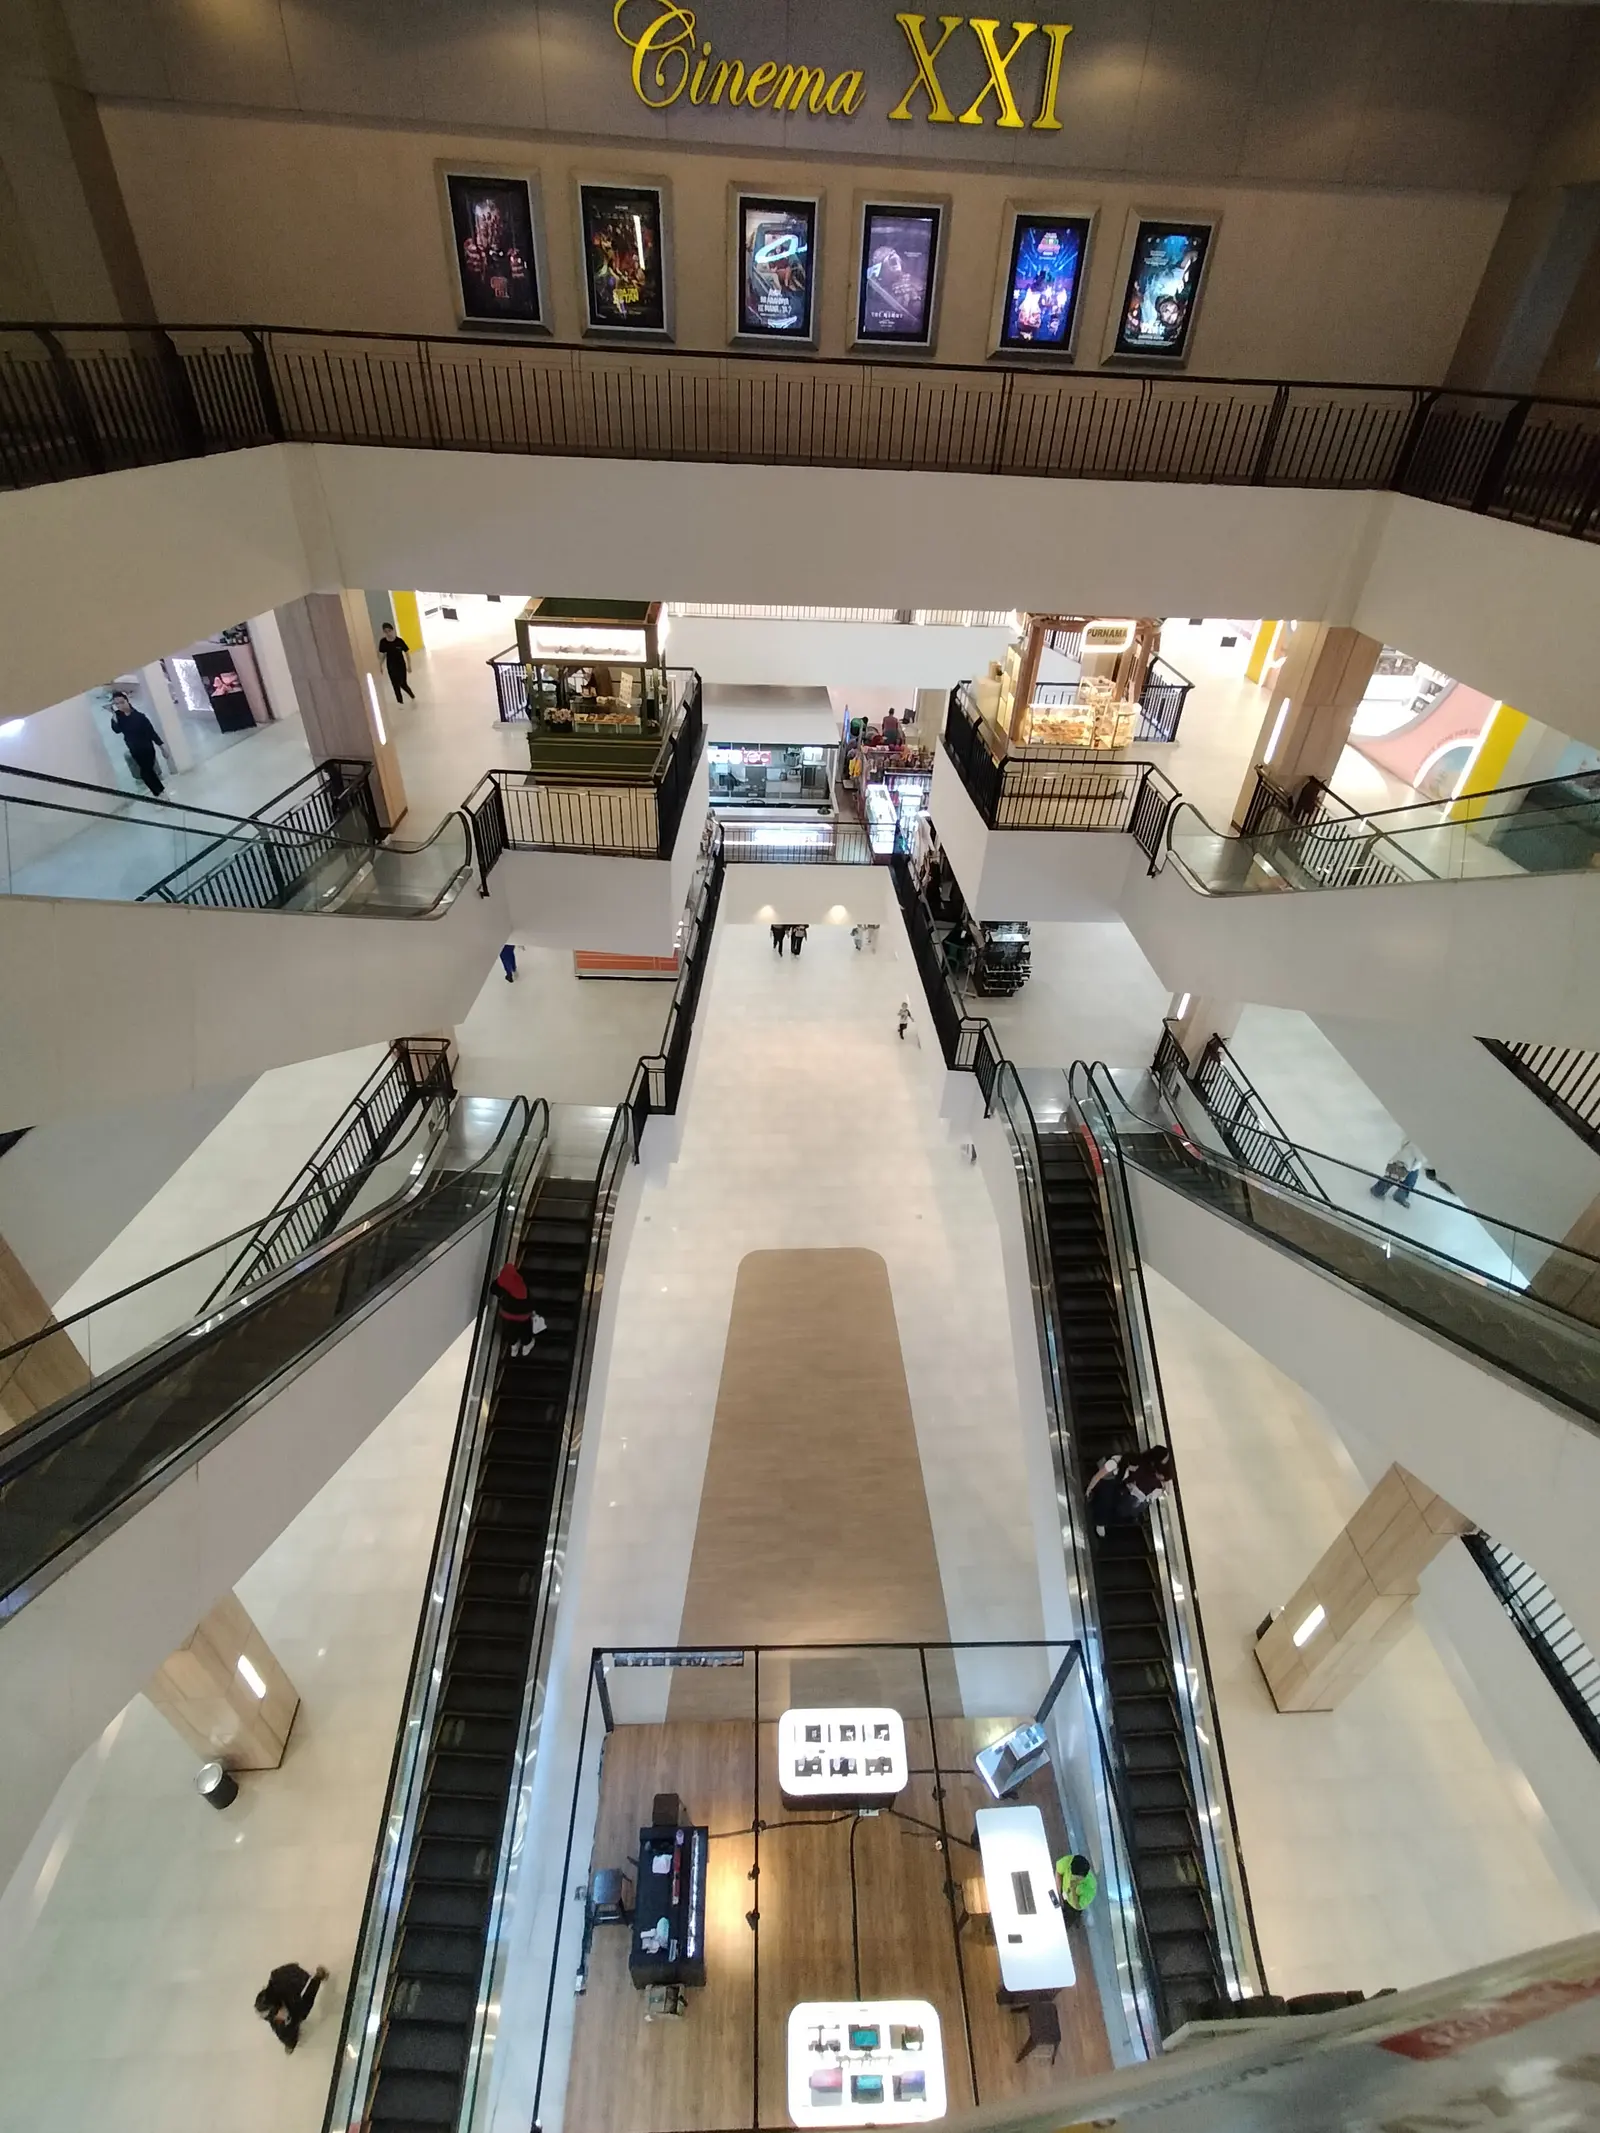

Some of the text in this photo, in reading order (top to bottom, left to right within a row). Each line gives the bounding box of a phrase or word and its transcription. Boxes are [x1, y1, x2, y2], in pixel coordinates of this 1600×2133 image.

[613, 0, 1074, 130] Cinema XXI
[1087, 628, 1127, 638] PURNAMA
